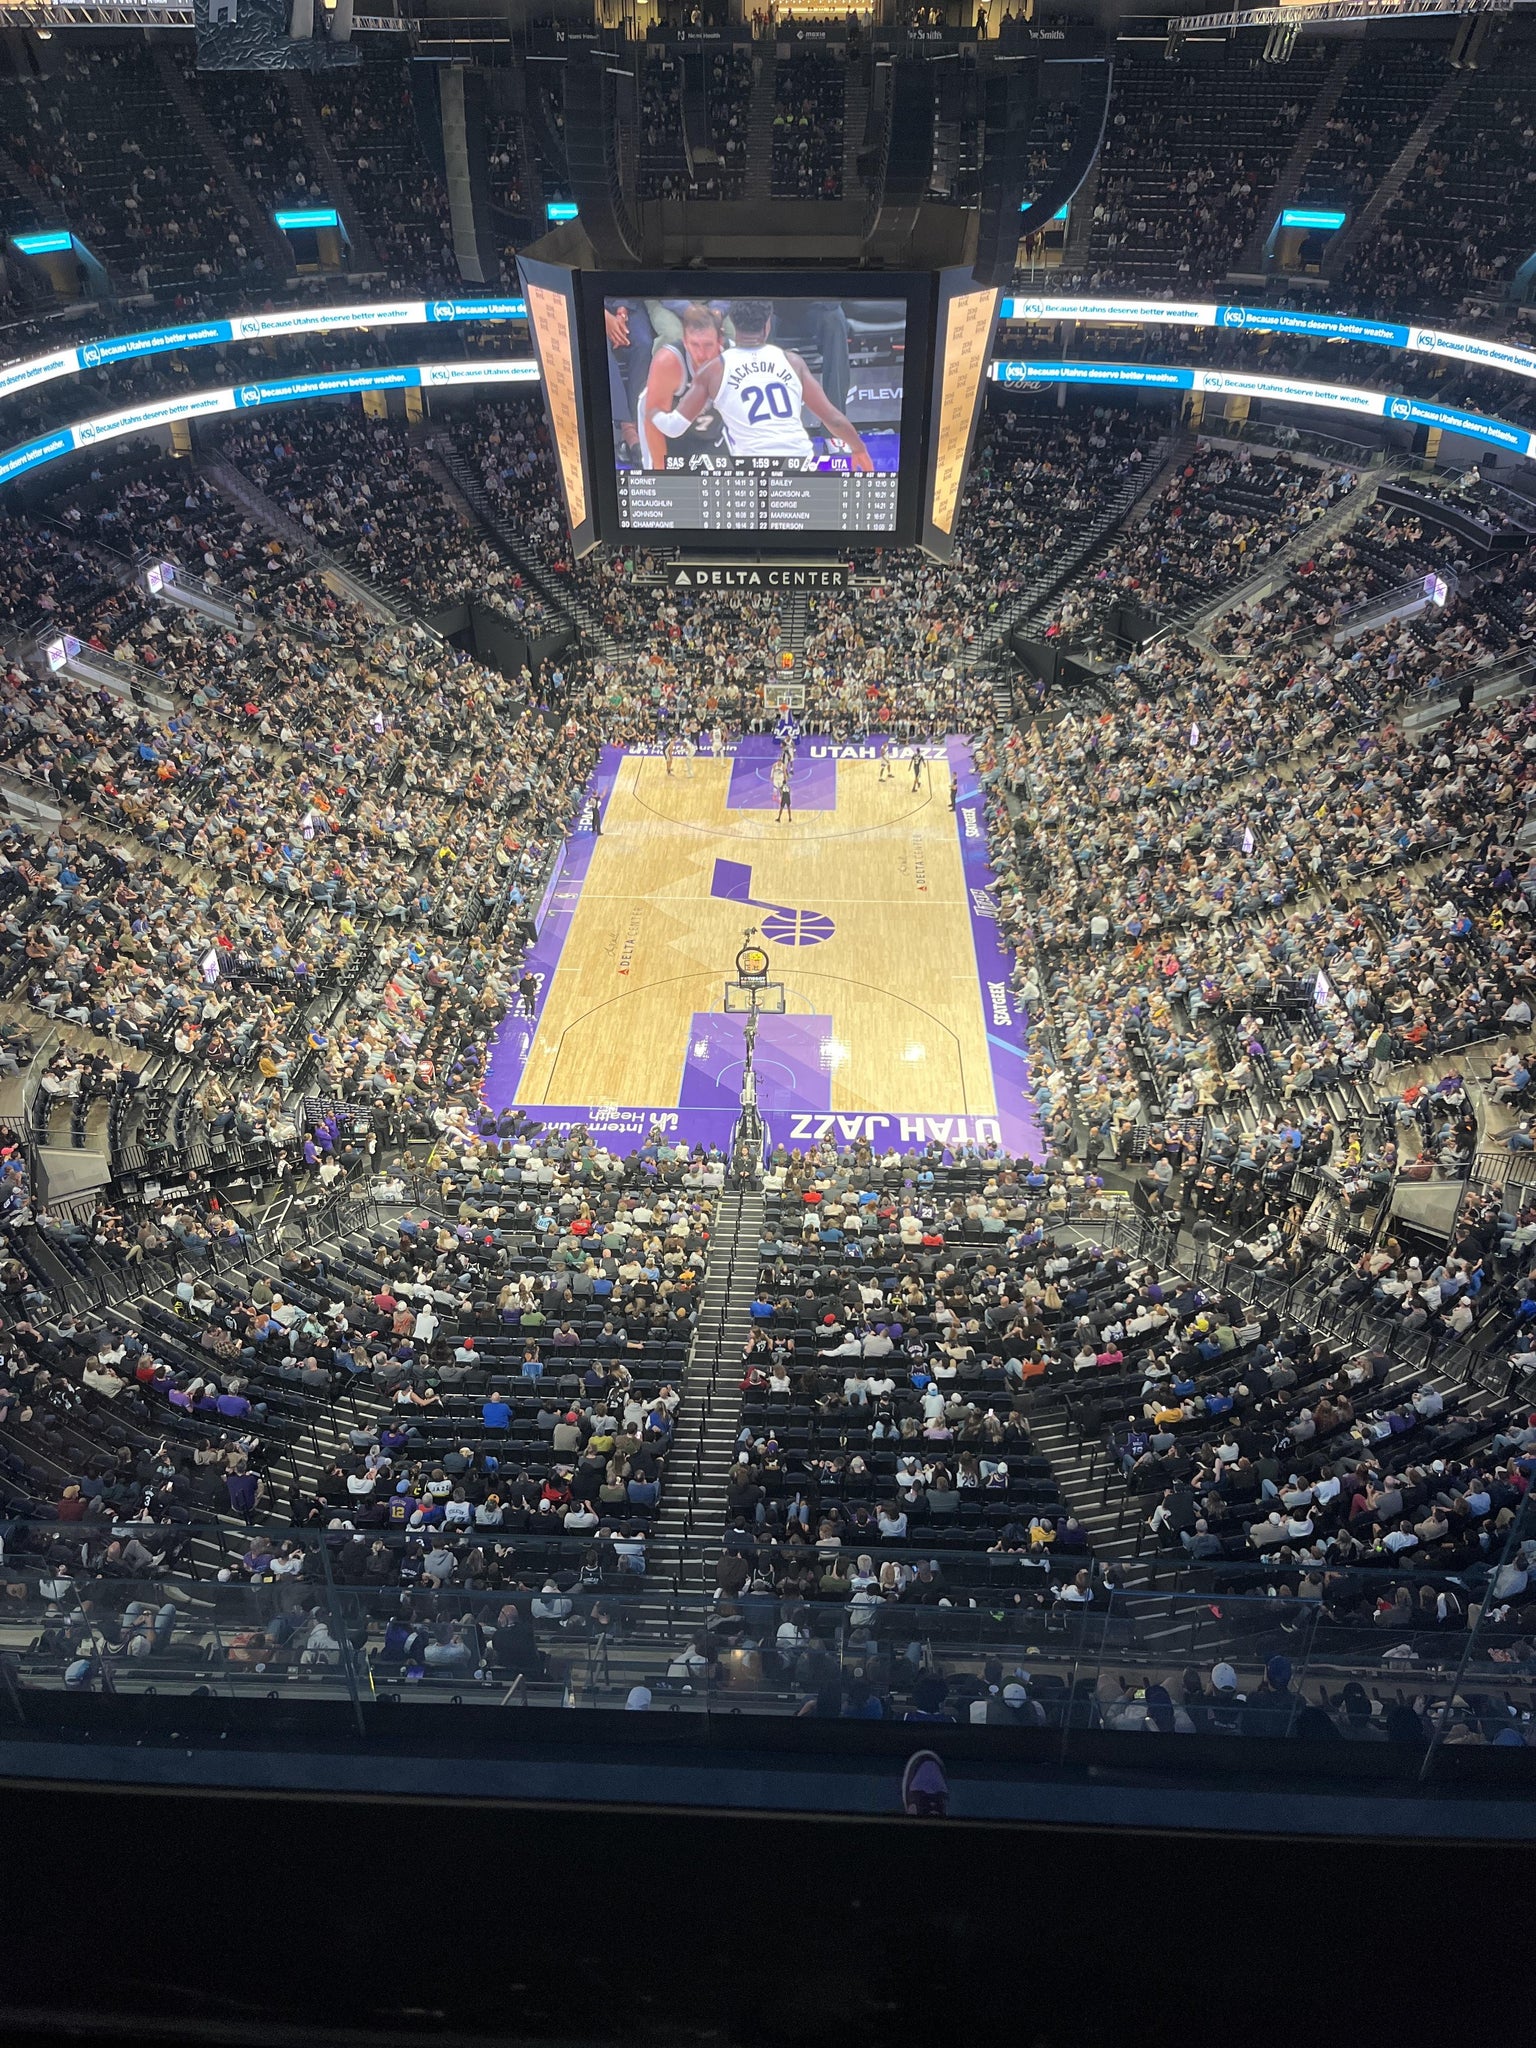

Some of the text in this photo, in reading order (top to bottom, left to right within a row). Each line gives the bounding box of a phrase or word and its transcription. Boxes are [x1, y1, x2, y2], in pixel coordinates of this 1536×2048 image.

[456, 306, 488, 314] Because
[489, 304, 516, 314] Utahns
[1079, 305, 1106, 314] Utahns
[1166, 308, 1199, 318] weather.
[262, 320, 292, 329] Because
[294, 317, 319, 326] Utahns
[320, 314, 350, 323] deserve
[352, 312, 374, 320] better
[1246, 314, 1279, 325] Because
[1280, 316, 1306, 328] Utahns
[1307, 320, 1338, 331] deserve
[1339, 324, 1363, 334] better
[1364, 327, 1394, 339] weather.
[101, 345, 126, 357] Because
[127, 339, 151, 352] Utahns
[165, 332, 187, 344] better
[188, 328, 219, 341] weather.
[1437, 339, 1464, 352] Because
[1465, 344, 1488, 356] Utahns
[1490, 348, 1513, 362] deserve
[1514, 355, 1532, 368] better
[26, 366, 42, 378] better
[728, 362, 792, 389] JACKSON JR.
[1028, 368, 1060, 377] Because
[1060, 368, 1087, 378] Utahns
[1089, 369, 1119, 379] deserve
[1120, 370, 1145, 380] better
[1145, 372, 1178, 382] weather.
[261, 387, 292, 398] Because
[294, 383, 318, 394] Utahns
[319, 380, 348, 390] deserve
[349, 376, 373, 386] better
[374, 374, 406, 384] weather.
[1225, 379, 1255, 388] Because
[1258, 383, 1283, 392] Utahns
[1284, 386, 1313, 396] deserve
[1315, 390, 1338, 400] better
[1340, 394, 1370, 406] weather.
[859, 388, 903, 400] FILEVI
[741, 382, 792, 425] 20
[96, 421, 119, 434] Because
[120, 414, 142, 426] Utahns
[143, 408, 168, 420] deserve
[169, 402, 188, 414] better
[1411, 406, 1440, 420] Because
[1440, 412, 1462, 427] Utahns
[1463, 420, 1487, 433] deserve
[667, 458, 684, 468] SAS
[752, 458, 770, 468] 1:59
[788, 459, 800, 469] 60
[831, 459, 848, 469] UTA
[697, 572, 842, 586] DELTA CENTER
[810, 746, 948, 759] UTAH JAZZ
[916, 861, 925, 884] DELTA
[620, 907, 643, 966] DELTA CENTER
[987, 981, 1012, 1026] SEATGEEK
[589, 1111, 645, 1122] Health
[790, 1114, 1002, 1143] UTAH JAZZ
[144, 1496, 150, 1507] 3
[392, 1506, 405, 1518] 12
